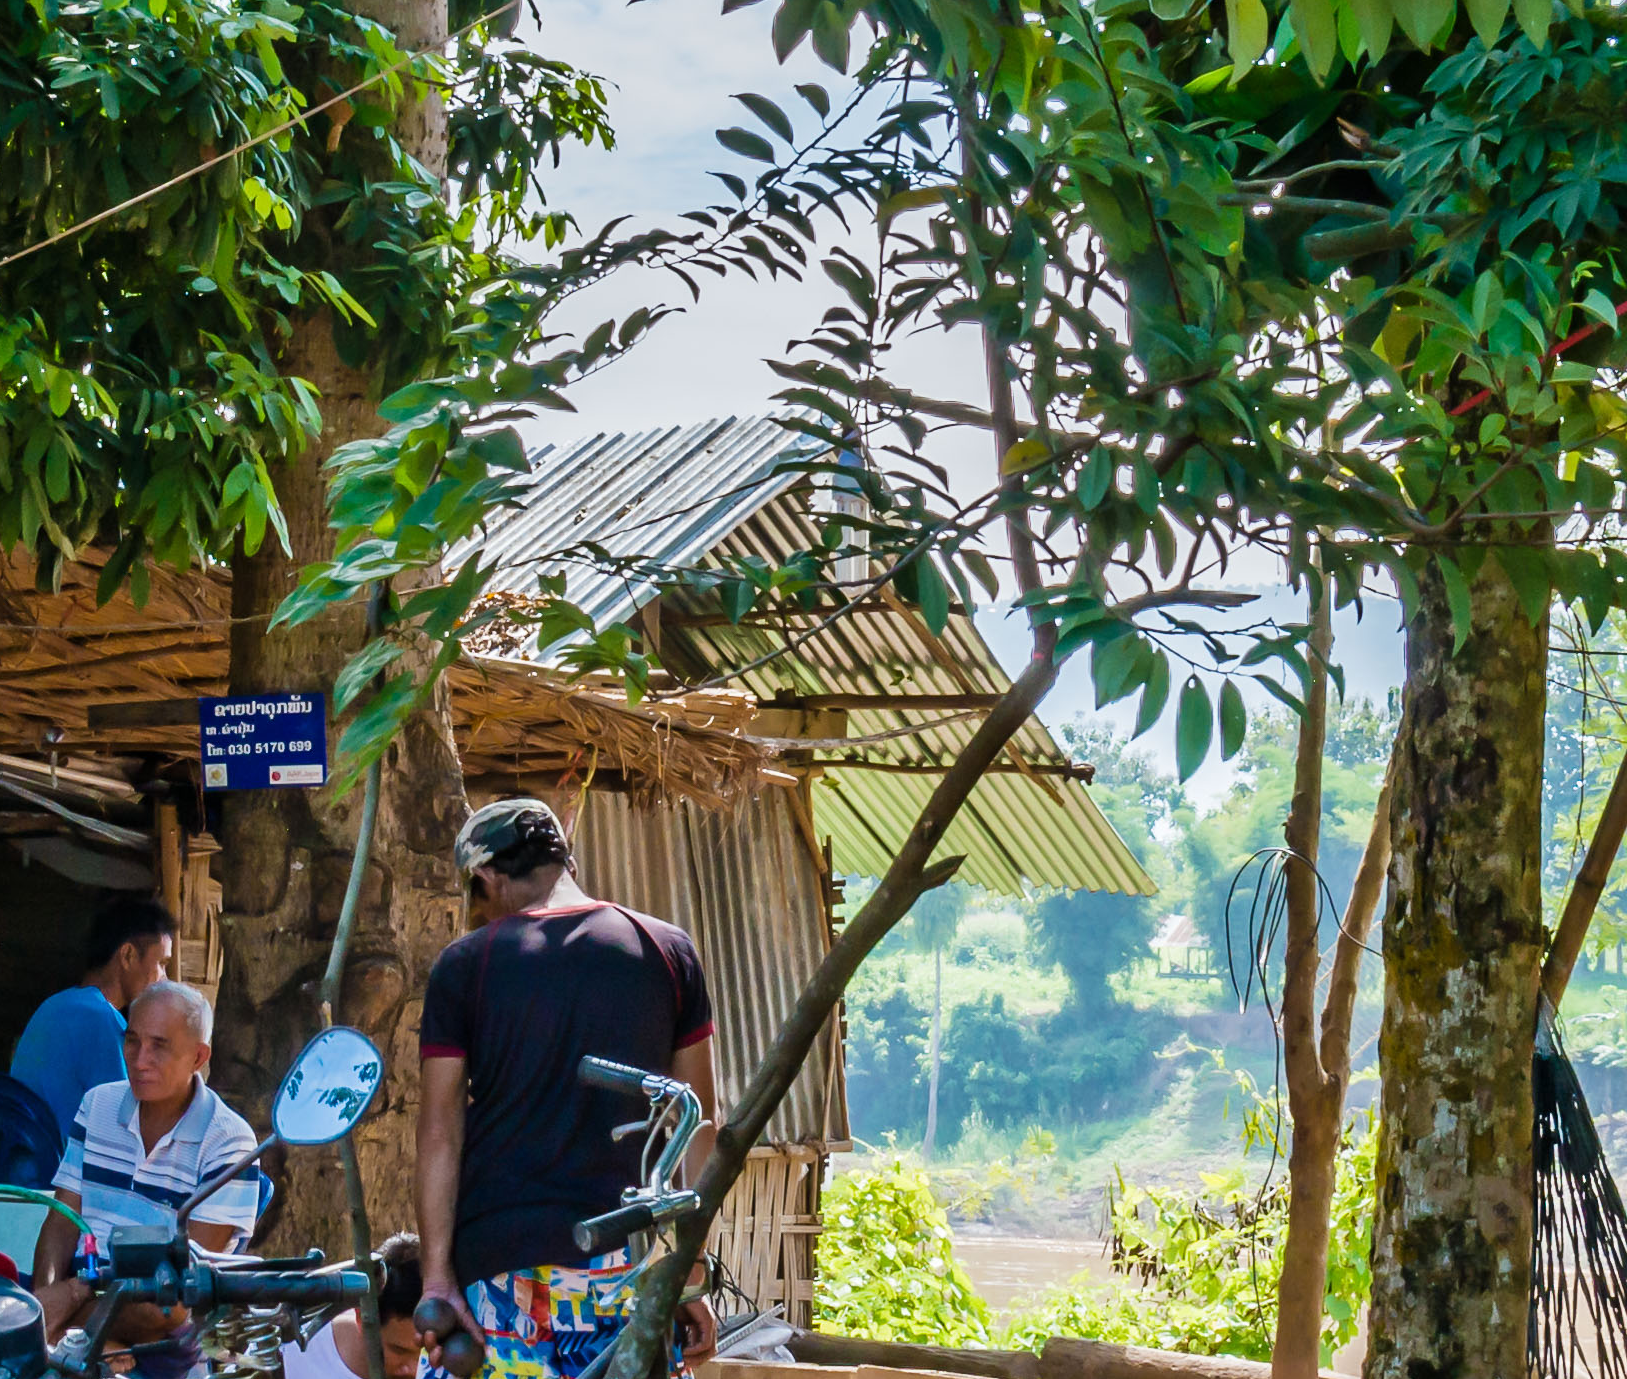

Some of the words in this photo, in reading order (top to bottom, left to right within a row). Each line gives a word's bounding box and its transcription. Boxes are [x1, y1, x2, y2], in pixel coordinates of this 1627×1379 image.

[227, 744, 251, 756] 030
[255, 741, 286, 754] 5170
[288, 740, 313, 752] 699
